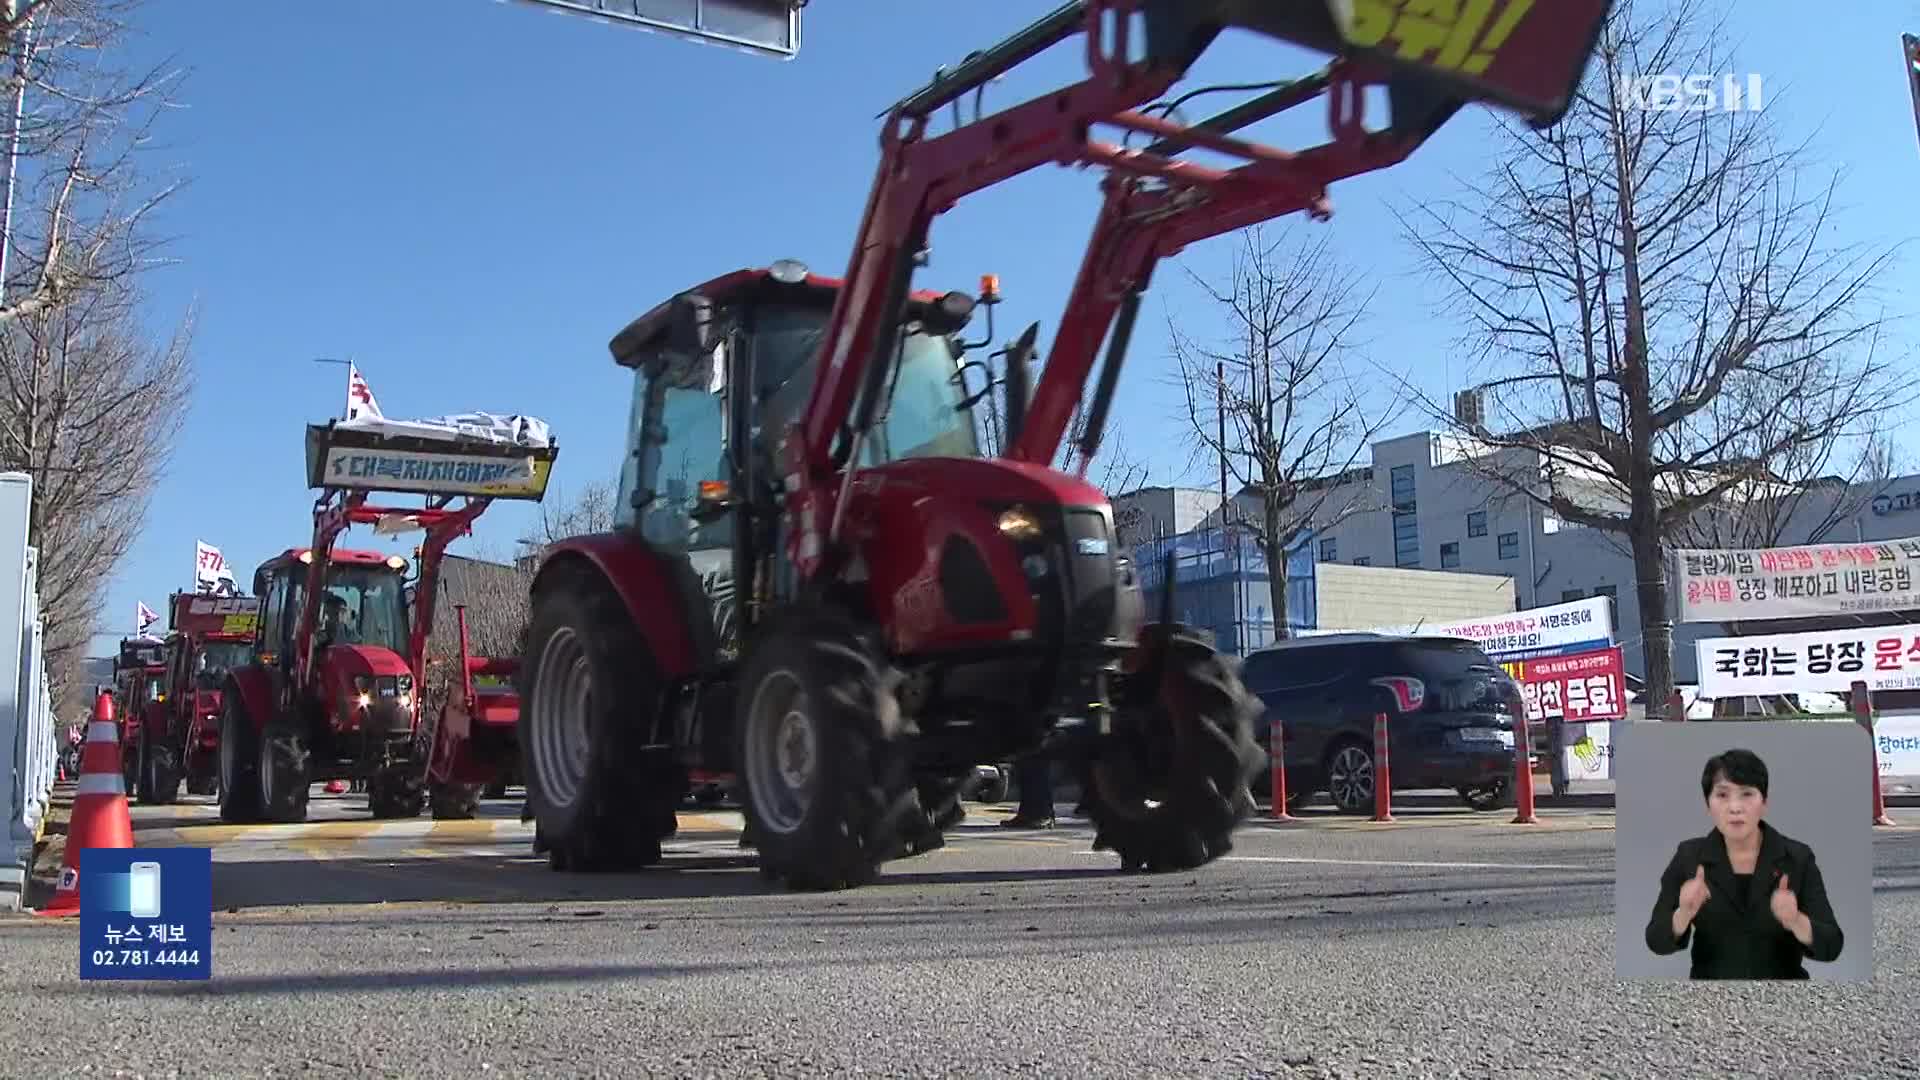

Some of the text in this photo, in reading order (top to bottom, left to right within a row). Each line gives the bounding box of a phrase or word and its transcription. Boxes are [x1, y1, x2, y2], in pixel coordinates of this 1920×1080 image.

[1688, 564, 1911, 603] 윤석열 당장 체포하고 내란공범
[1539, 609, 1593, 629] 서명운동에
[1715, 646, 1798, 678] 국회는
[1807, 640, 1866, 674] 당장
[1566, 673, 1619, 717] 무효!
